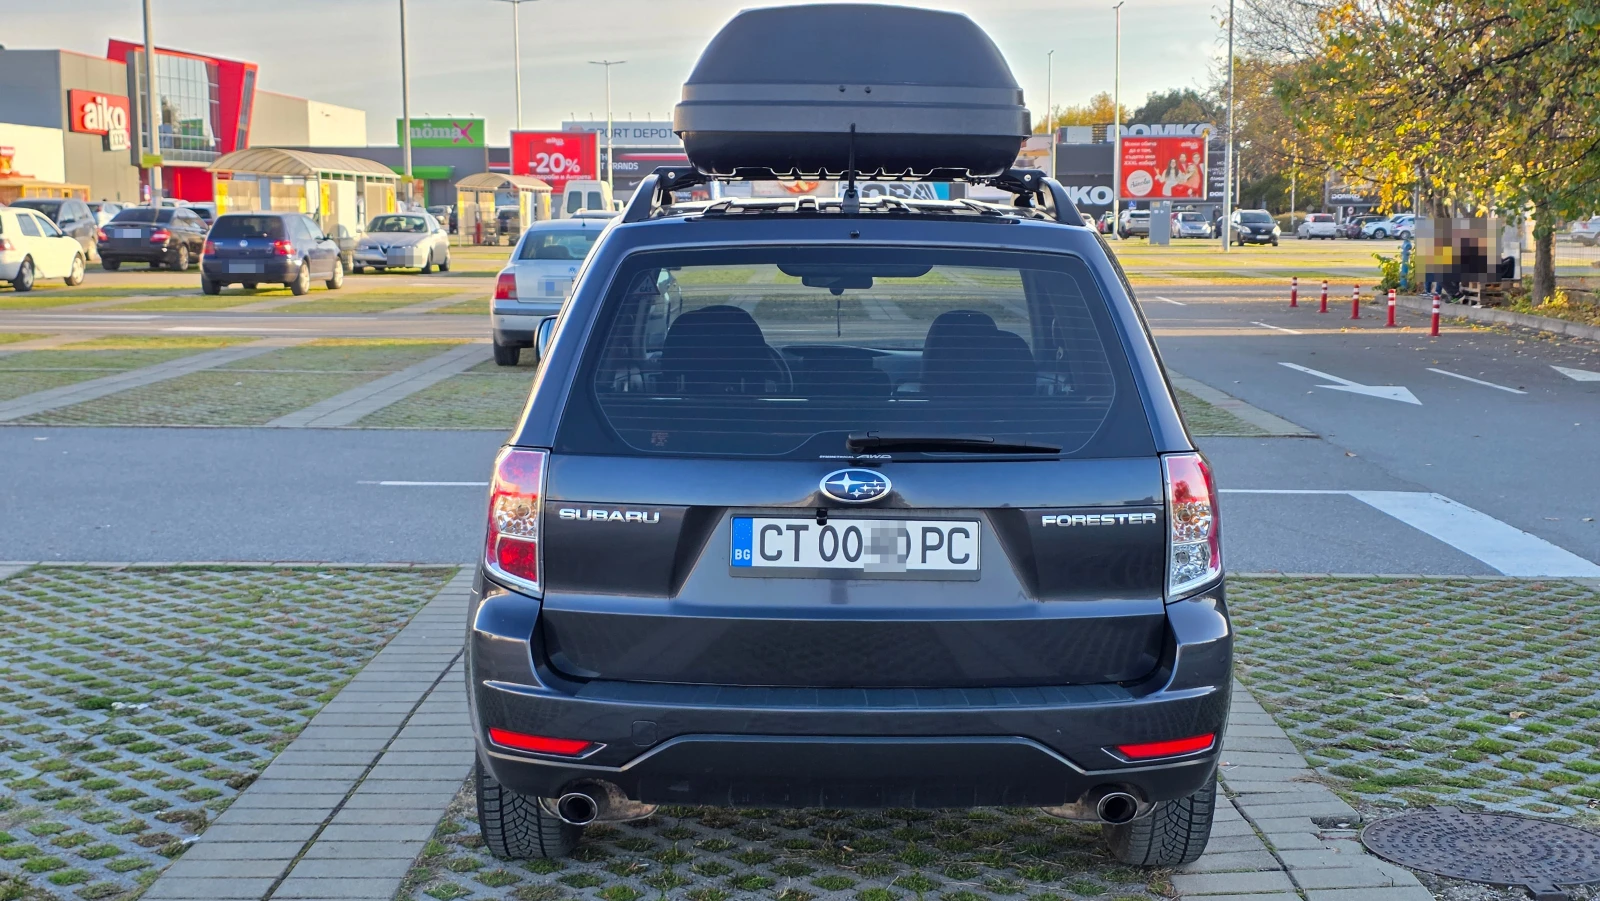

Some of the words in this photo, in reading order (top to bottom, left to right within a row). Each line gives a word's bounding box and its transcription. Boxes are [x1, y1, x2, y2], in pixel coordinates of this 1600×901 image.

[84, 96, 126, 131] aiko
[633, 127, 674, 139] DEPOT
[1106, 123, 1218, 142] DOMKO
[528, 152, 581, 173] -20%
[612, 162, 639, 171] RANDS
[559, 508, 660, 524] SUBARU
[1041, 512, 1157, 527] FORESTER
[759, 523, 809, 562] CT
[818, 524, 912, 564] 00
[921, 526, 970, 565] PC
[734, 548, 751, 560] BG
